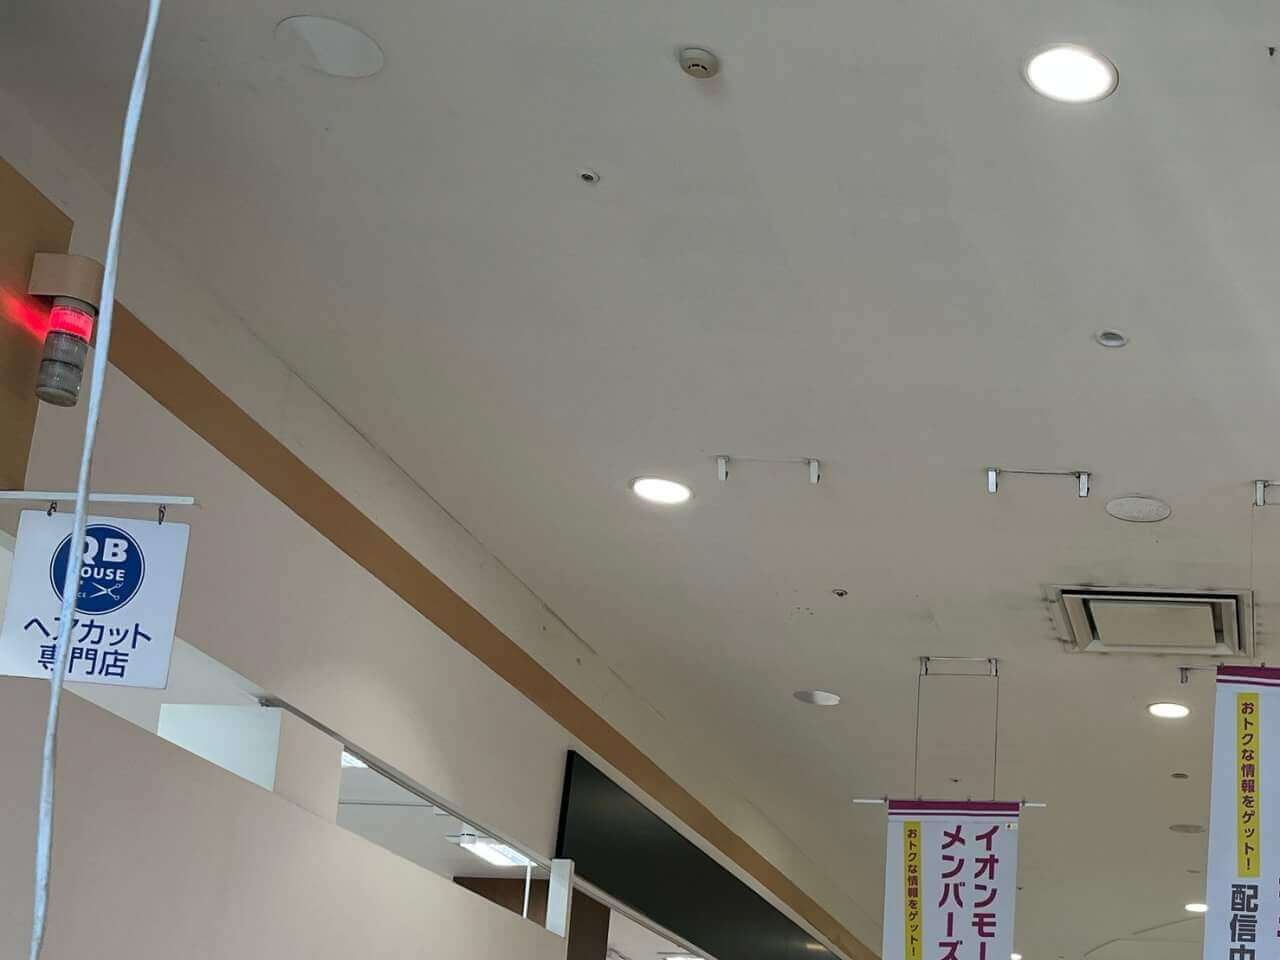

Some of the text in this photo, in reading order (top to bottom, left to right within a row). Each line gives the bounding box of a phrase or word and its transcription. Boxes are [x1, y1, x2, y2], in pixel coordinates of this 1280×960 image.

[80, 566, 126, 581] OUSE
[38, 644, 129, 678] 専門店
